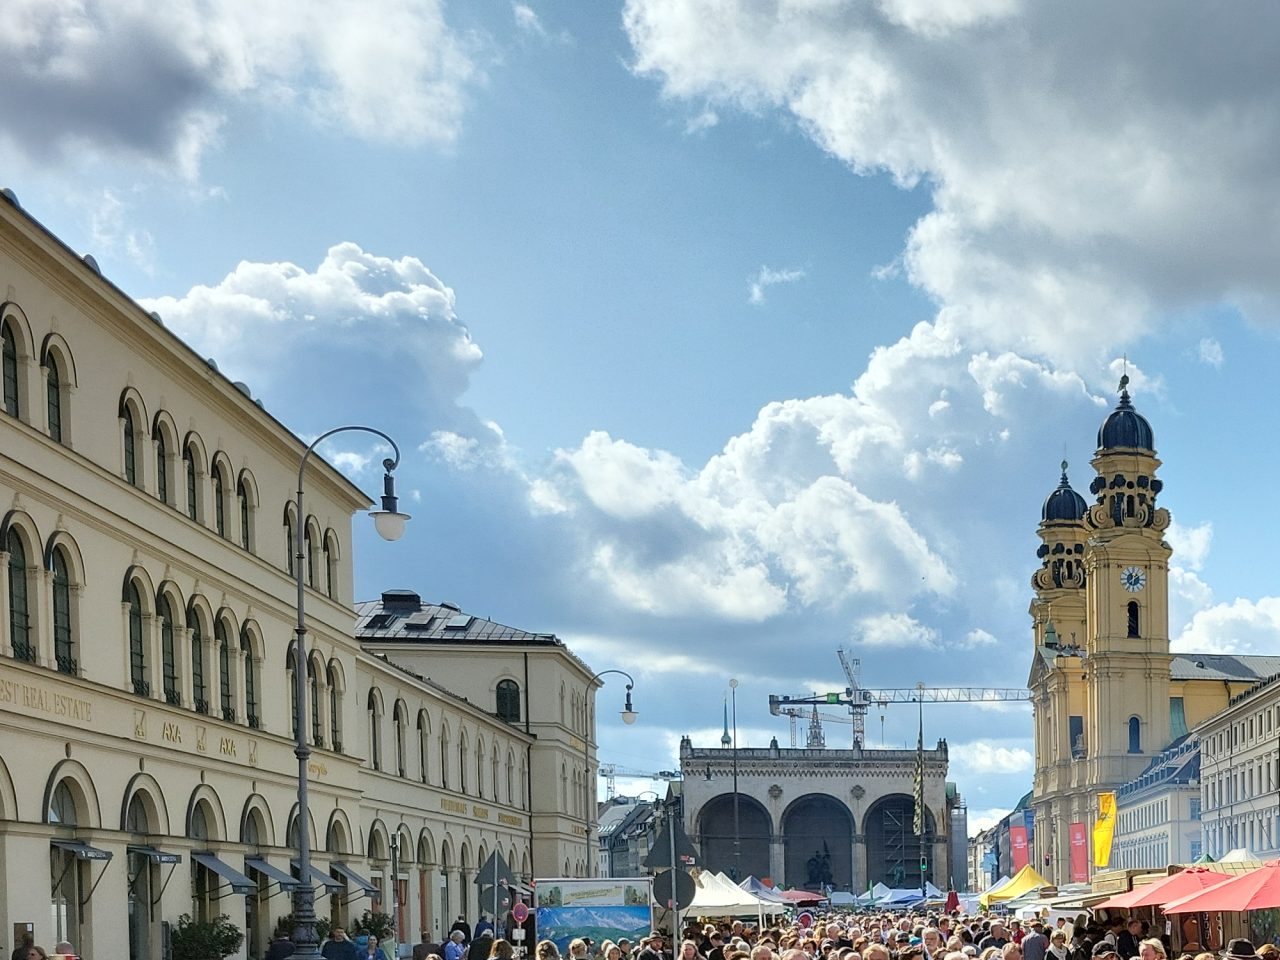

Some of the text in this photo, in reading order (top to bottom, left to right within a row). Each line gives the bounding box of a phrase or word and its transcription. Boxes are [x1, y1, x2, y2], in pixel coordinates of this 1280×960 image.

[22, 684, 51, 712] REAL
[54, 693, 92, 722] ESTATE
[162, 721, 237, 757] AXA AXA
